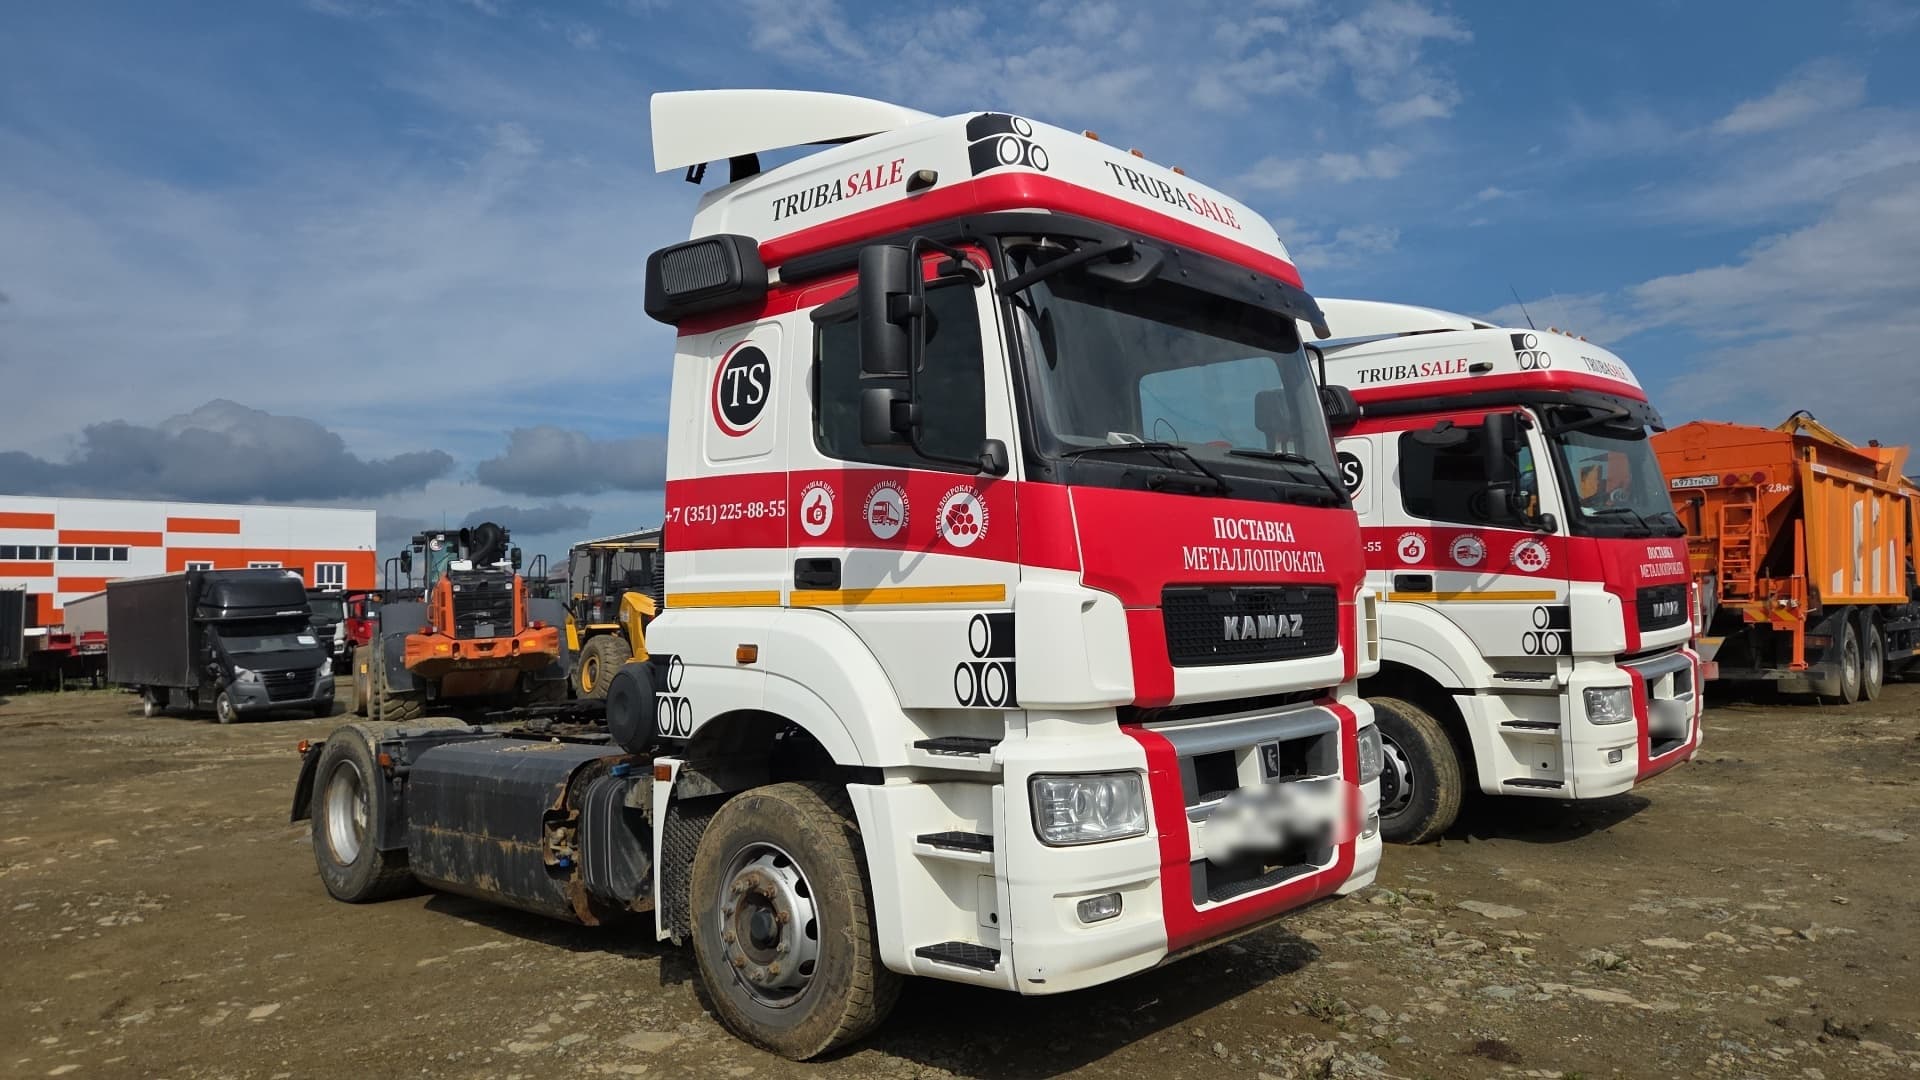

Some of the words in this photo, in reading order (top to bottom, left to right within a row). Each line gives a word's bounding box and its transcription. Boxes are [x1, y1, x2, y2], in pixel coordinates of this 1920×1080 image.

[772, 158, 905, 221] TRUBASALE
[1104, 160, 1241, 230] TRUBASALE
[1358, 358, 1468, 384] TRUBASALE
[727, 363, 765, 407] TS
[665, 507, 681, 522] +7
[684, 504, 717, 526] (351)
[720, 499, 786, 520] 225-88-55
[935, 484, 974, 538] МЕТАЛЛОПРОКАТ
[1213, 517, 1296, 543] ПОСТАВКА
[1183, 546, 1326, 573] МЕТАЛЛОПРОКАТА
[1224, 614, 1303, 640] KAMAZ
